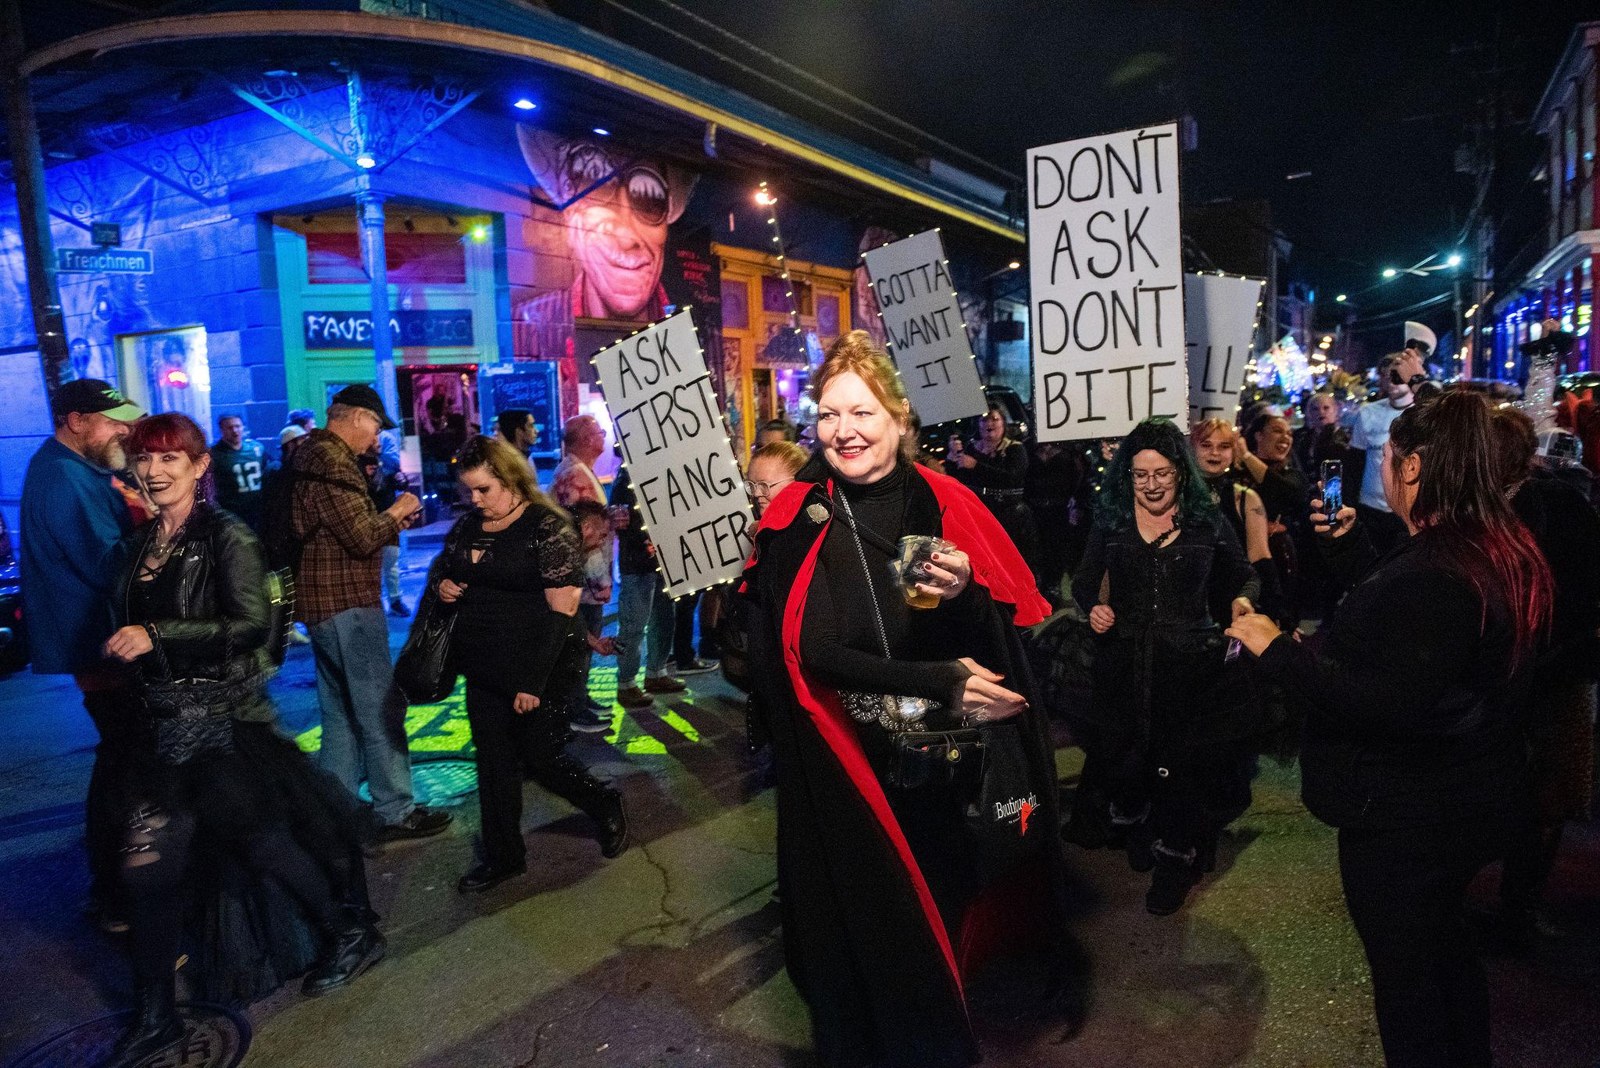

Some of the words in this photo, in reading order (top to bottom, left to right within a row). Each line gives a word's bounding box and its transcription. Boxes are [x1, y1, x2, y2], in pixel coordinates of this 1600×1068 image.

[1034, 130, 1172, 209] DON'T
[65, 251, 145, 269] Frenchmen
[1051, 206, 1160, 285] ASK
[876, 259, 952, 308] GOTTA
[1038, 279, 1178, 355] DON'T
[307, 315, 400, 341] FAVEA
[889, 306, 951, 350] WANT
[618, 328, 682, 399] ASK
[915, 355, 951, 389] IT
[1044, 361, 1179, 429] BITE
[614, 373, 715, 464] FIRST
[233, 461, 262, 493] 12
[639, 452, 737, 525] FANG
[656, 510, 755, 587] LATER
[995, 797, 1026, 818] Boutique
